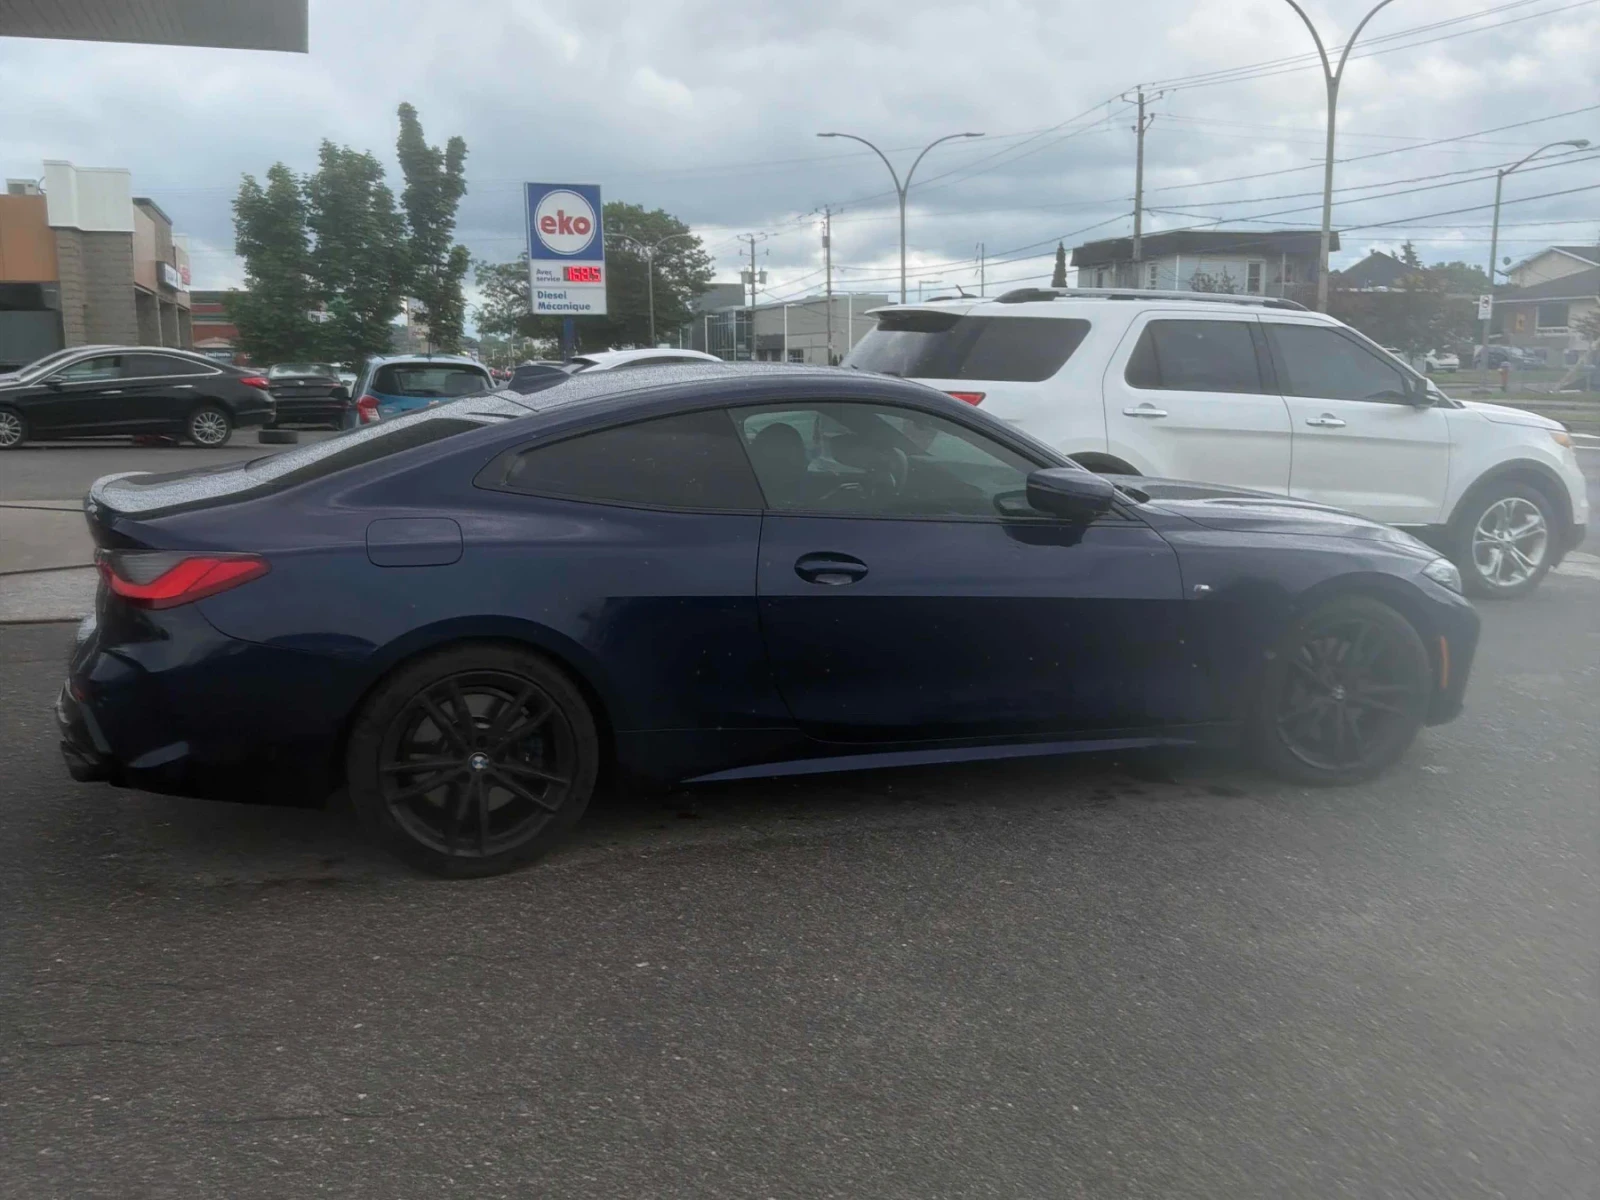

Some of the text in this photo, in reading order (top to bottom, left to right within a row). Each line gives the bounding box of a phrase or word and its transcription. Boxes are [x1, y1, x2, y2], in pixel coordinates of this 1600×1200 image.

[540, 209, 591, 235] eko
[537, 290, 567, 299] Diesel
[537, 301, 591, 311] Mécanique
